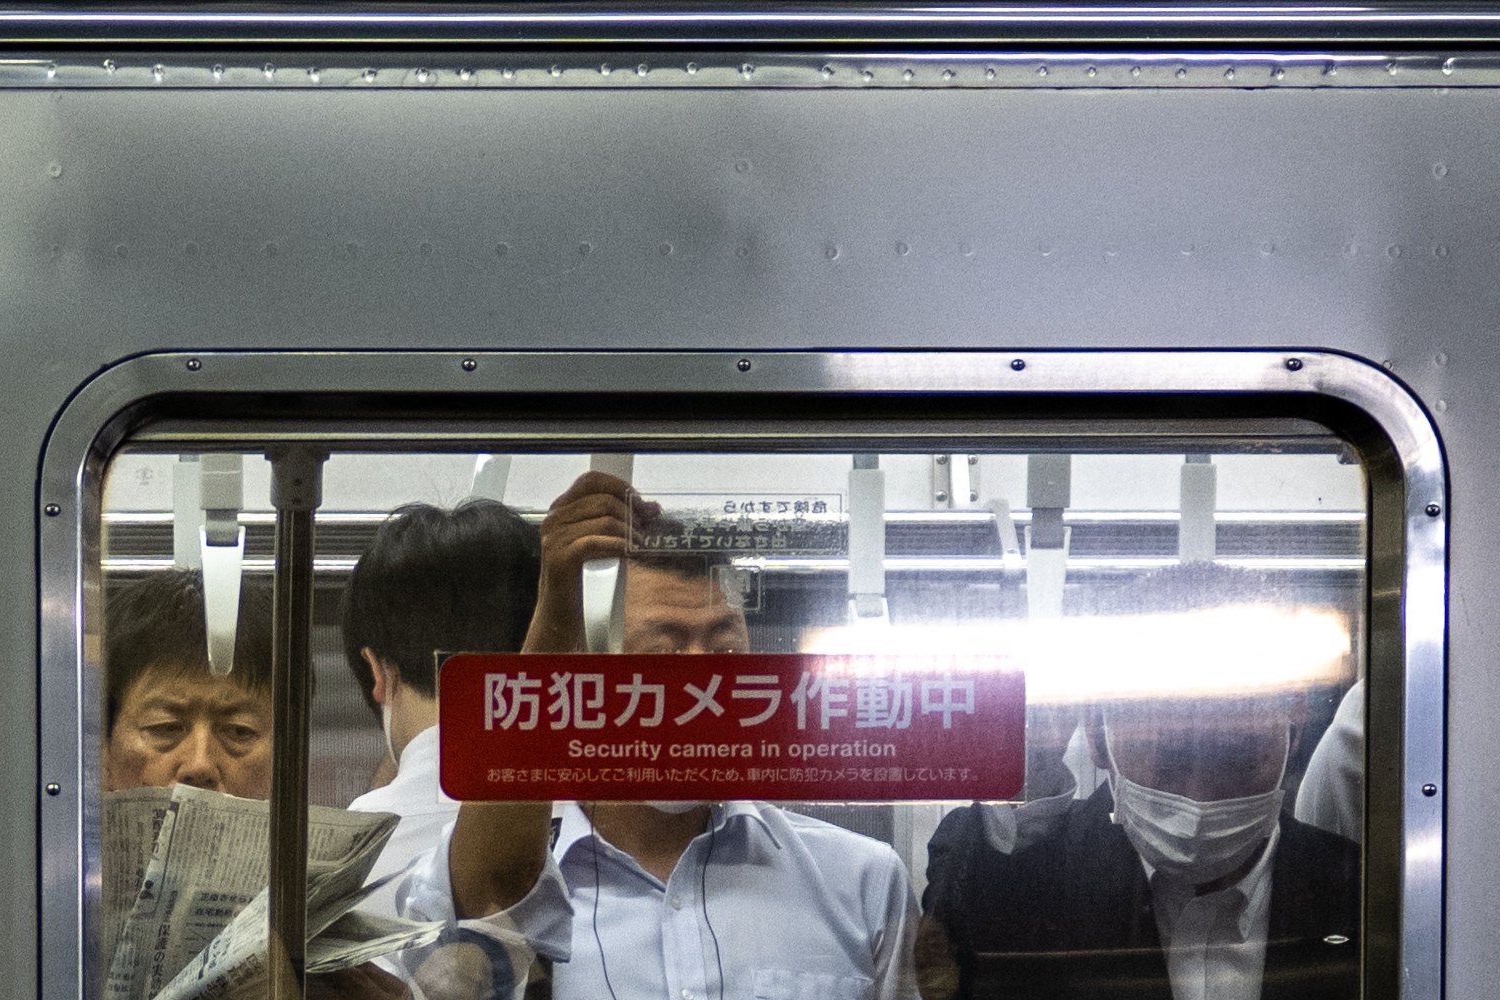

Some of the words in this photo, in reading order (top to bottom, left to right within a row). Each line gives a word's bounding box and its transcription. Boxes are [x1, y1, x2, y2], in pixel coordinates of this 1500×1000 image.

[483, 671, 977, 731] 防犯カメラ作動中
[567, 738, 662, 760] Security
[668, 740, 753, 757] camera
[760, 738, 780, 757] in
[787, 738, 897, 760] operation
[486, 767, 980, 784] お客さまに安心してご利用いただくため、車内に防犯カメラを設置しています。
